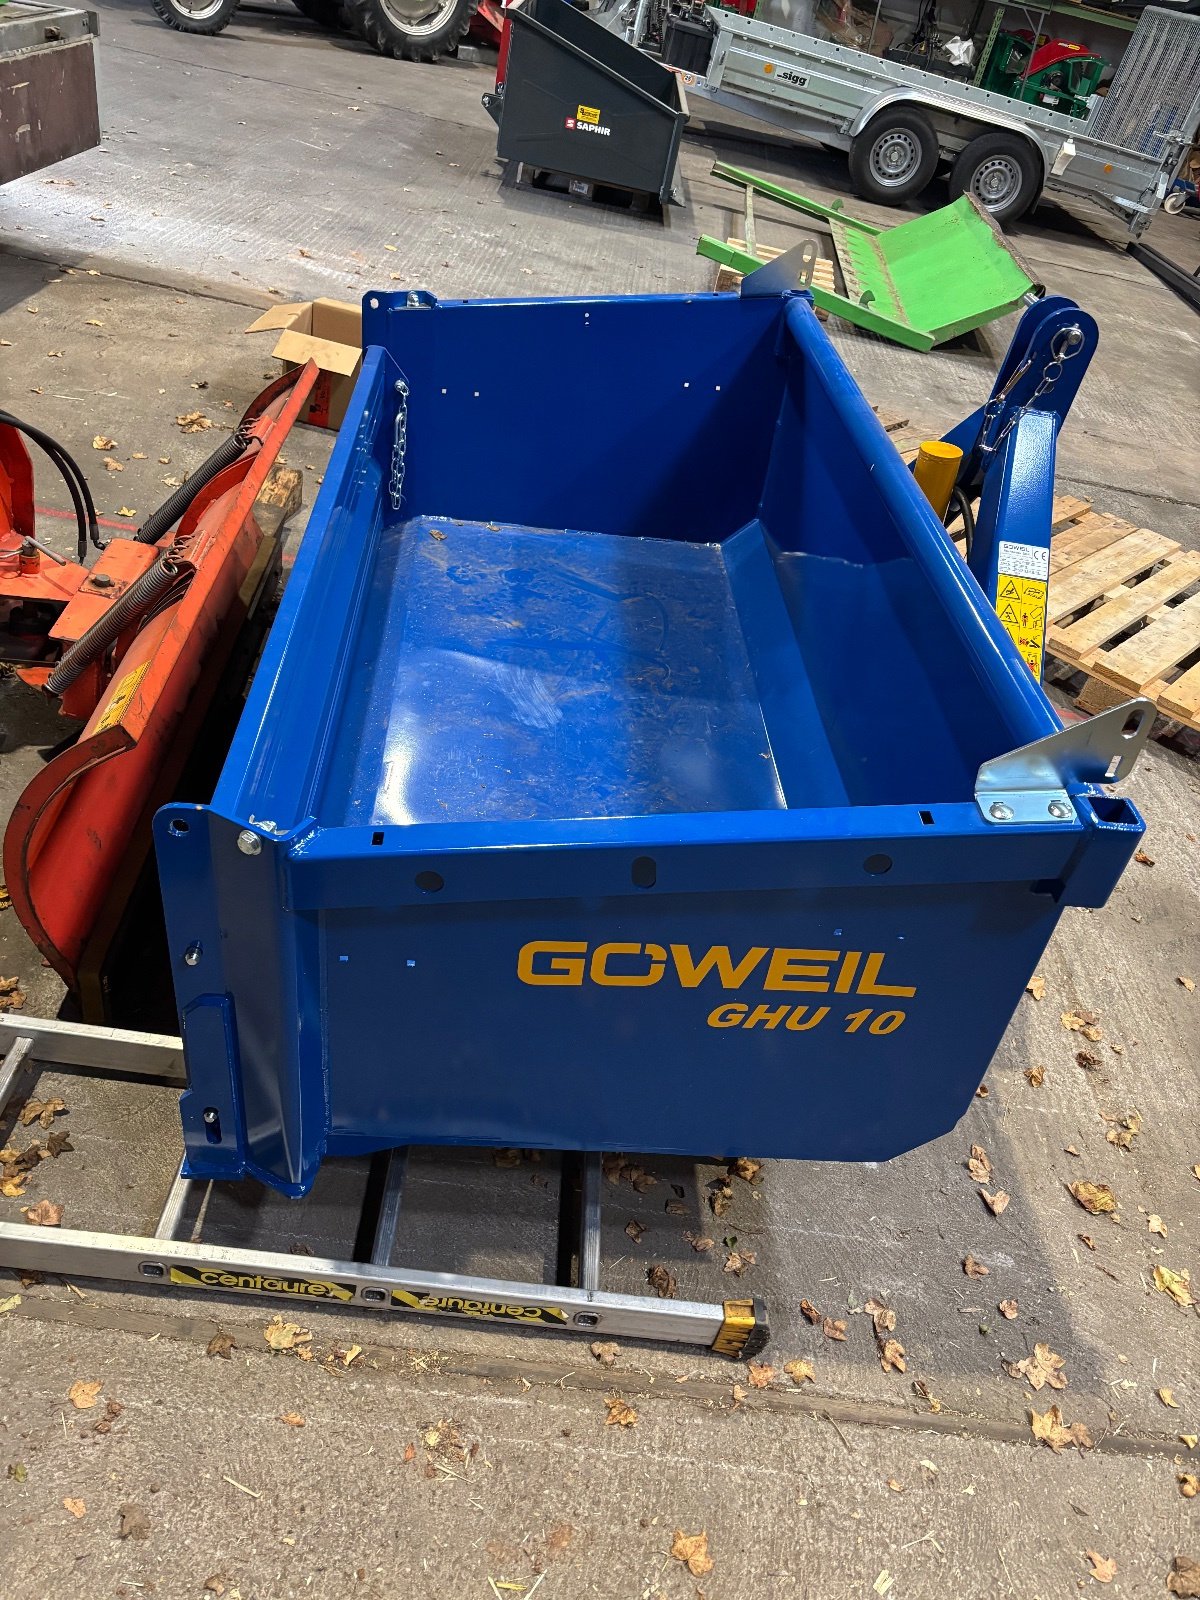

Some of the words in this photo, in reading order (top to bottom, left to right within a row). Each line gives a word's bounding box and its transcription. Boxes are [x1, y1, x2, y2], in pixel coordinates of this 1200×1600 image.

[576, 121, 611, 136] SAPHIR
[706, 1003, 831, 1031] GHU
[844, 1008, 907, 1035] 10
[200, 1272, 328, 1296] centaure
[420, 1296, 543, 1318] centaure
